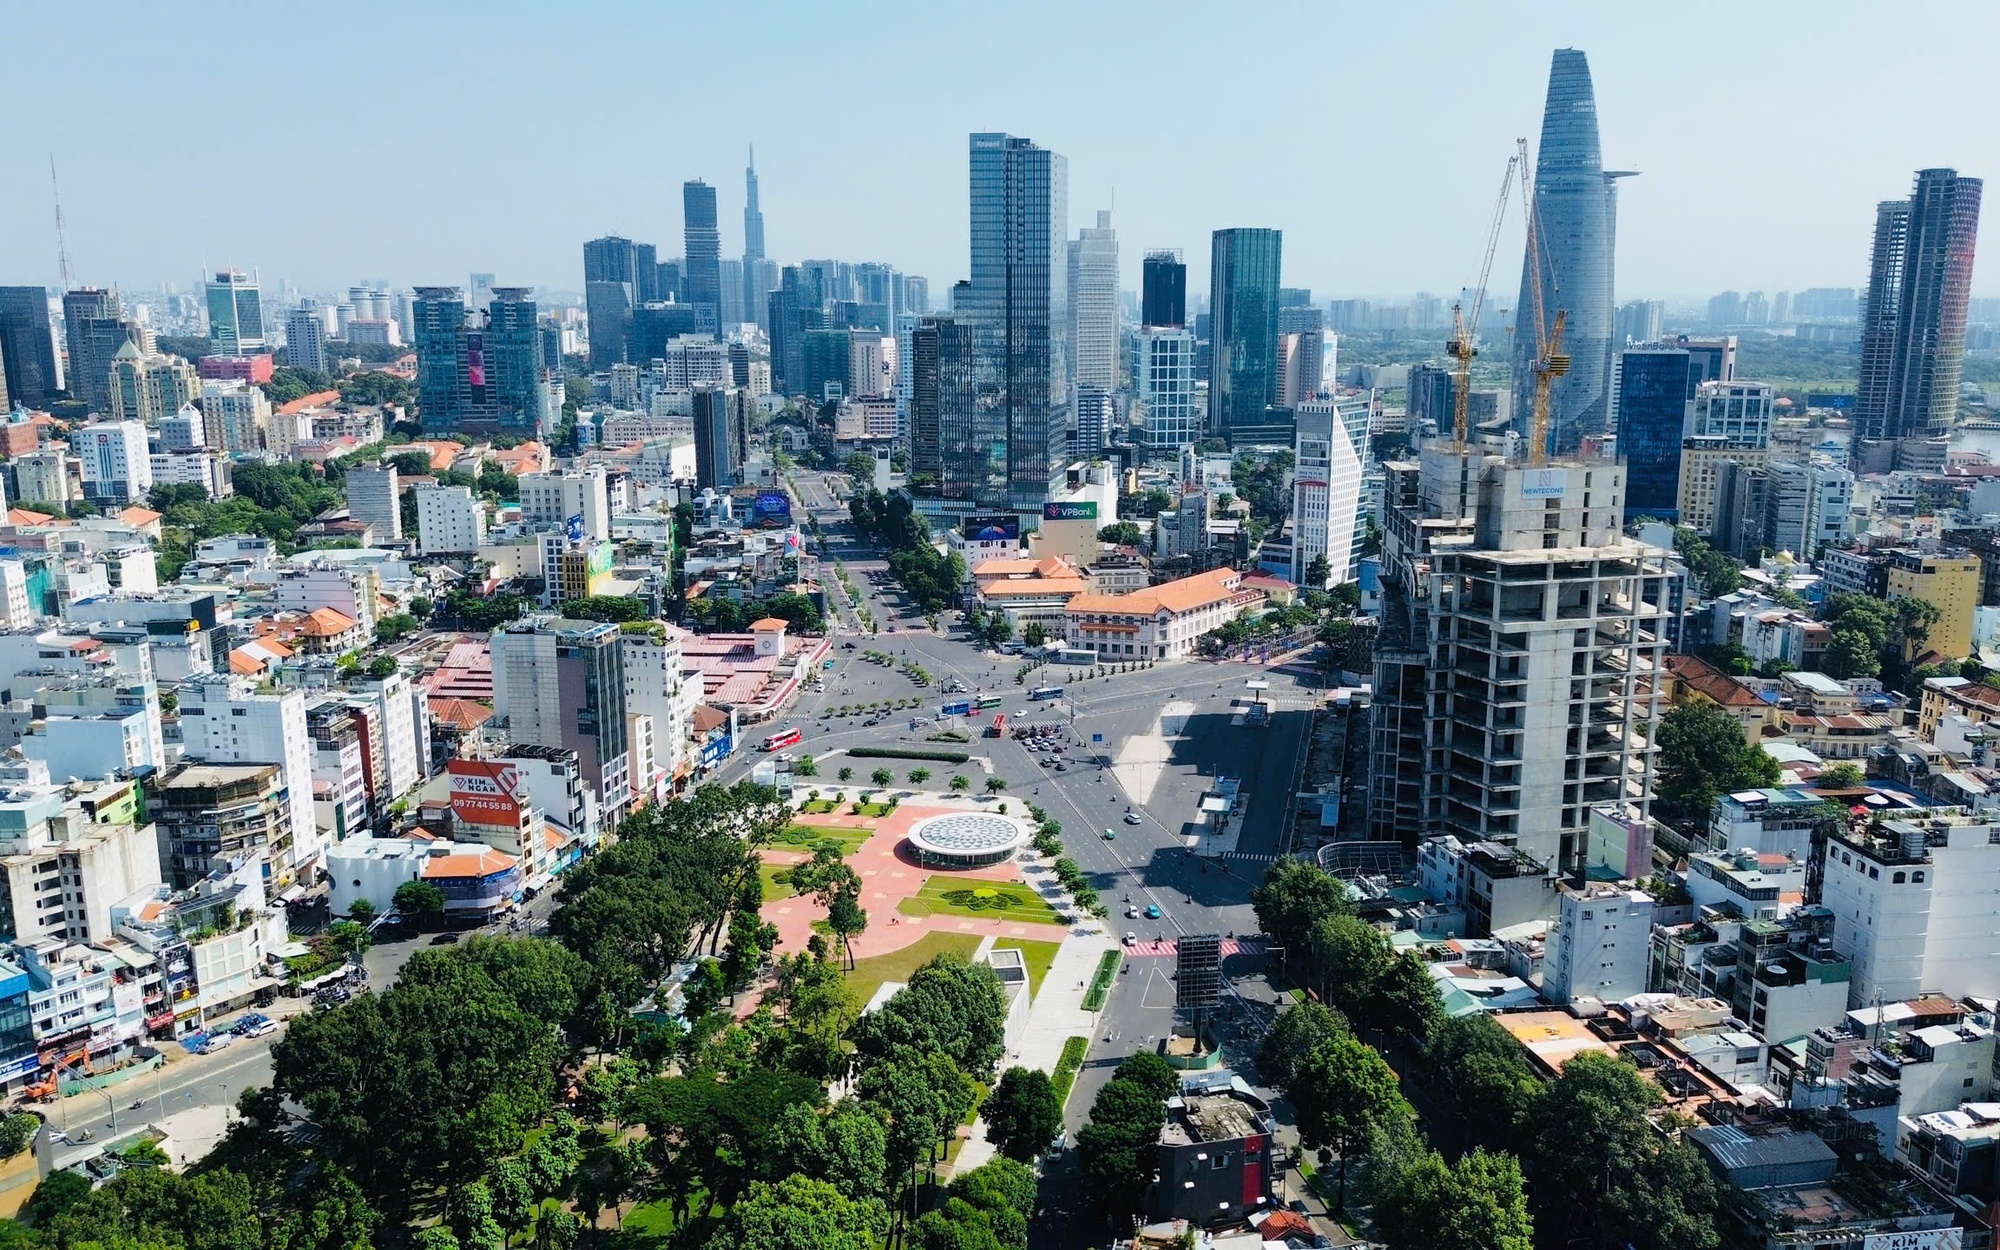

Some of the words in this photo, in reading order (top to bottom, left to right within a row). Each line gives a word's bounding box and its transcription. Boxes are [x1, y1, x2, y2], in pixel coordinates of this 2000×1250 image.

[699, 309, 711, 317] FOR
[696, 319, 716, 327] LEASE
[1316, 392, 1330, 401] MB
[1061, 507, 1093, 516] VPBank
[1892, 1237, 1918, 1247] KIM
